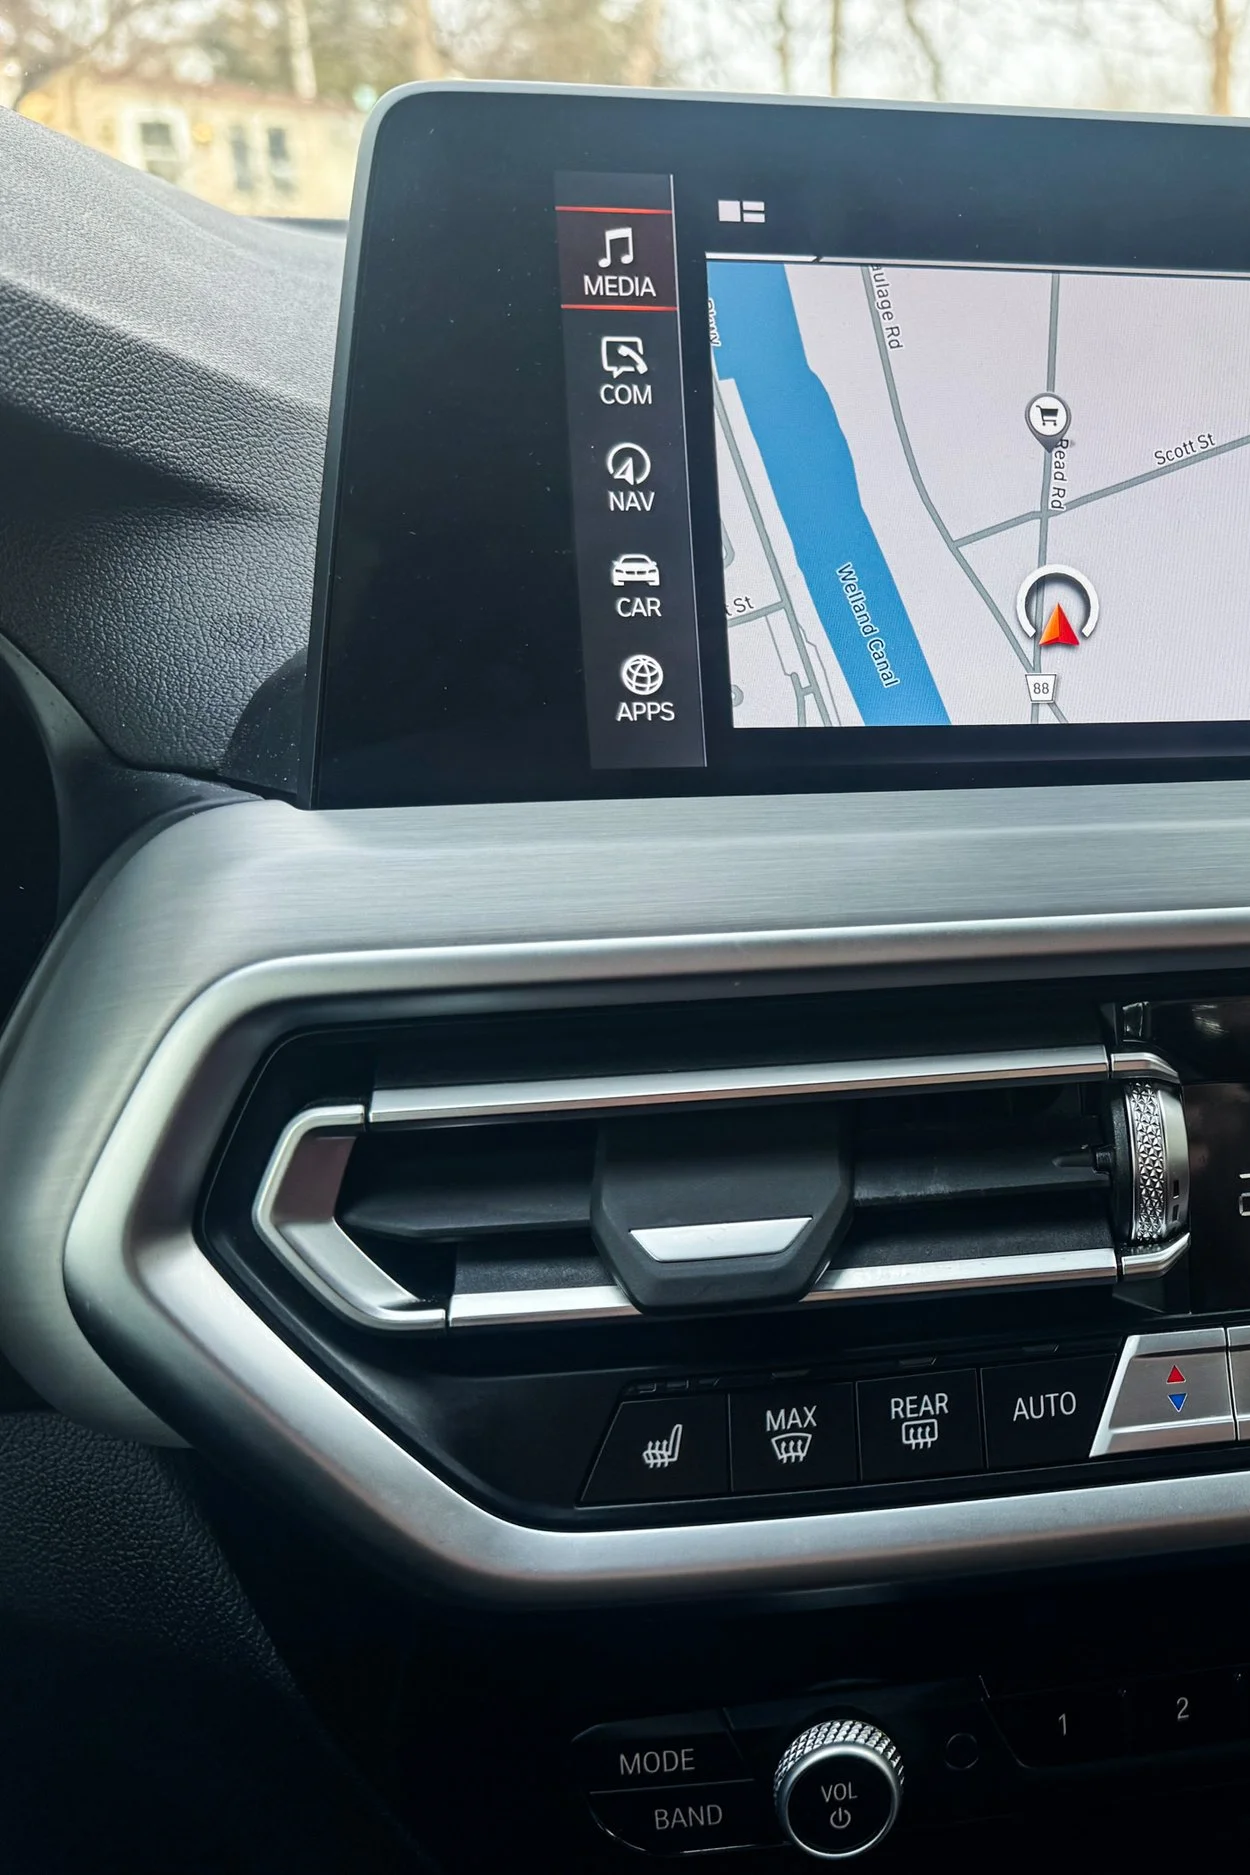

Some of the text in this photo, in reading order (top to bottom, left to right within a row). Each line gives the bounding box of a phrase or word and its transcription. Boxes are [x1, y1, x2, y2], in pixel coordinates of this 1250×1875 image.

[583, 276, 656, 298] MEDIA
[885, 326, 904, 350] Rd
[600, 384, 653, 406] COM
[1154, 432, 1216, 466] Scott St
[1051, 438, 1069, 510] Read Rd
[608, 491, 655, 512] NAV
[616, 597, 662, 618] CAR
[733, 596, 754, 613] St
[838, 563, 899, 687] Welland Canal
[1033, 682, 1050, 695] 88
[616, 702, 675, 722] APPS
[766, 1405, 818, 1431] MAX
[890, 1392, 949, 1420] REAR
[1013, 1390, 1077, 1422] AUTO
[1176, 1696, 1190, 1720] 2
[1058, 1712, 1068, 1737] 1
[618, 1748, 696, 1776] MODE
[821, 1782, 858, 1803] VOL
[654, 1804, 723, 1830] BAND
